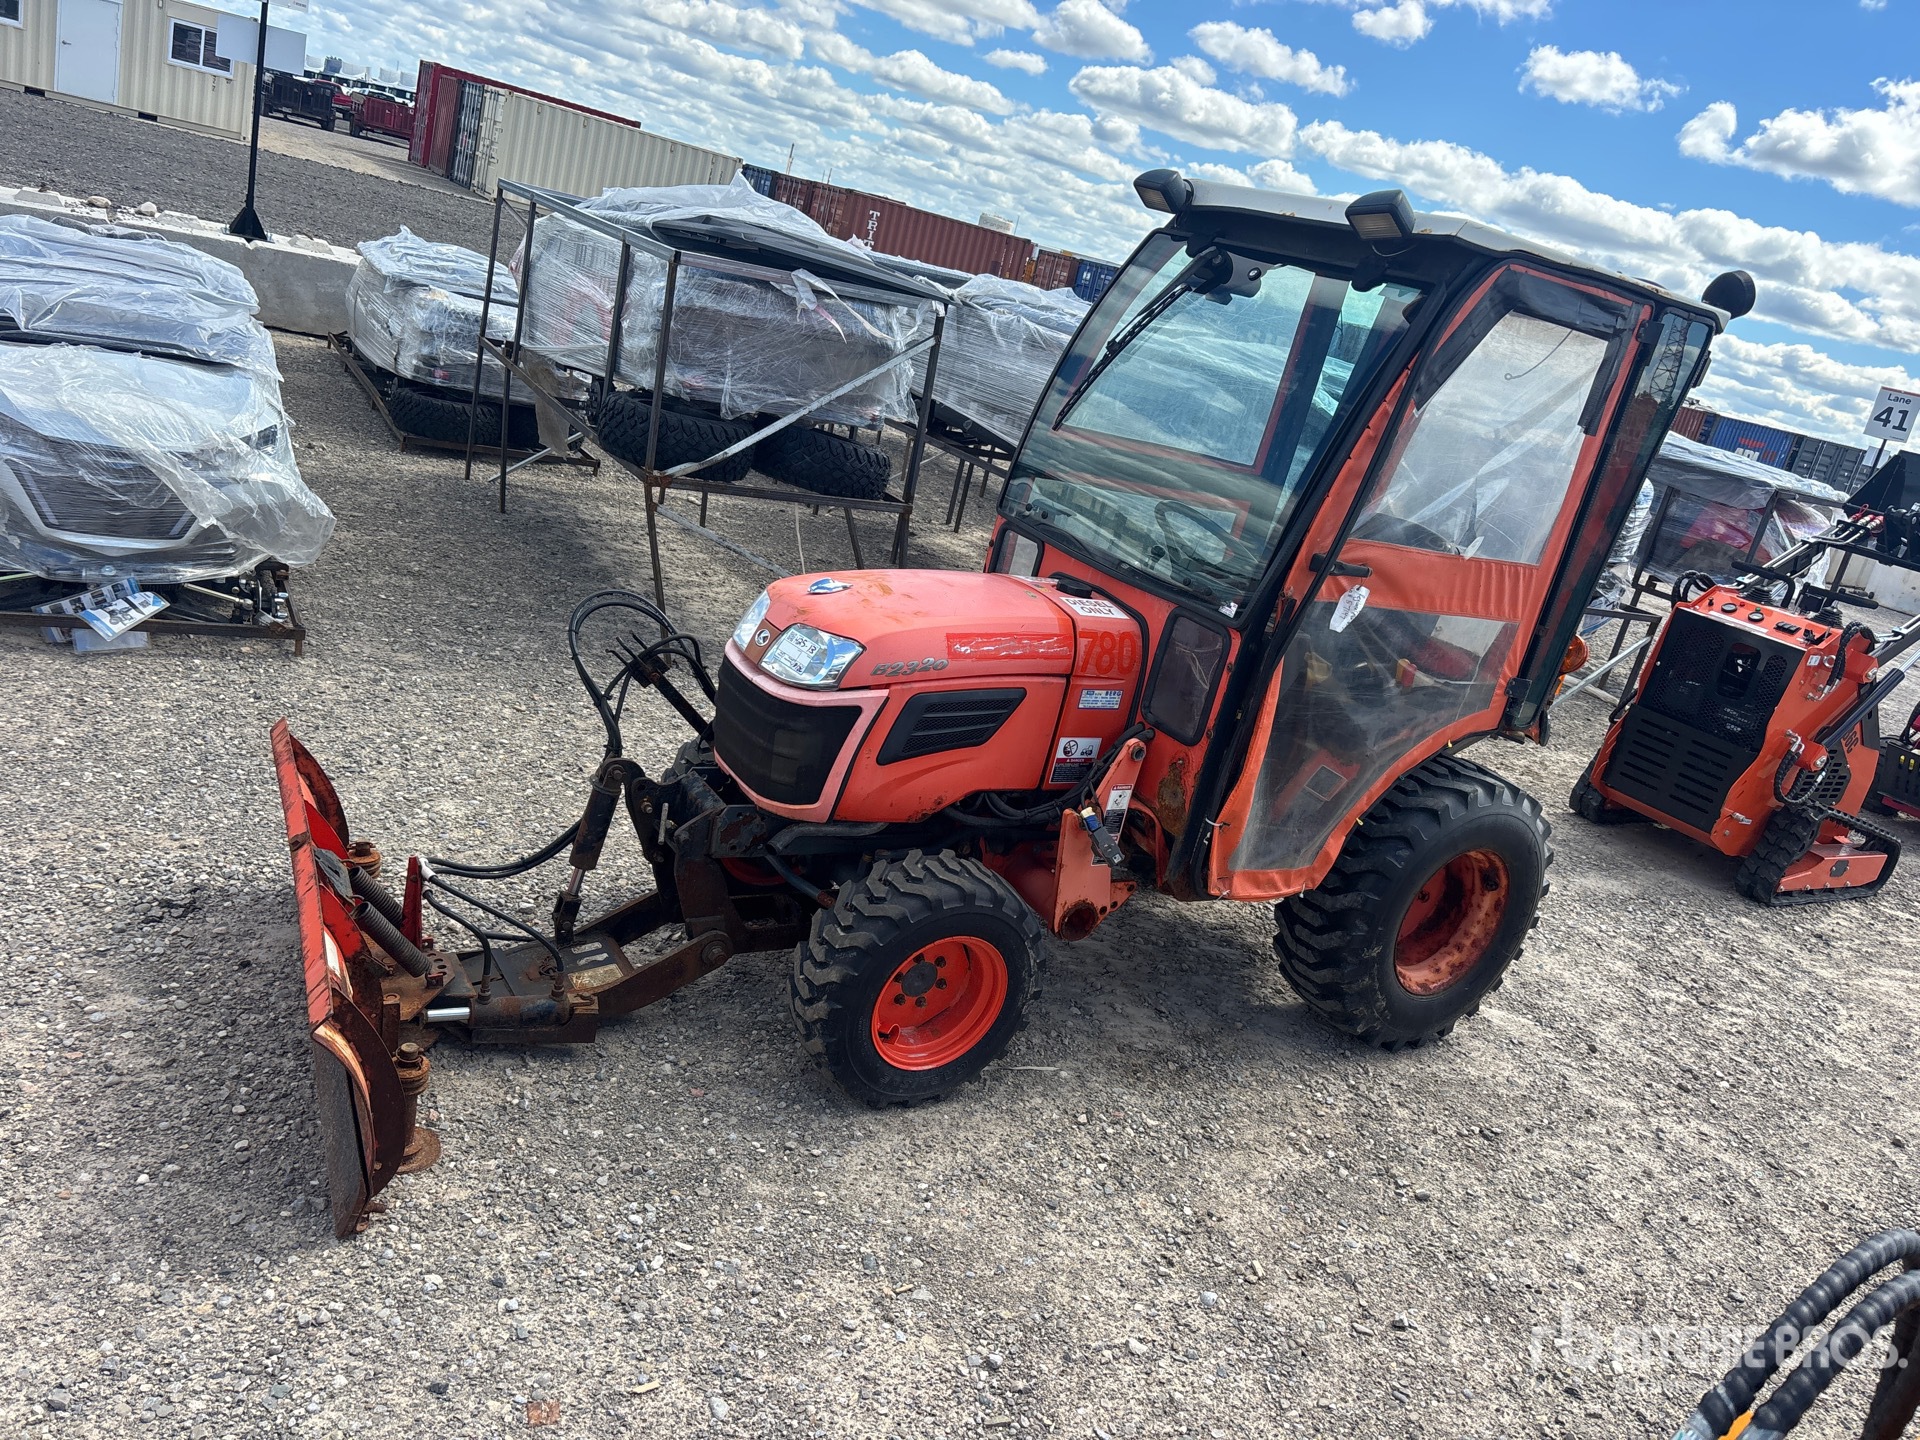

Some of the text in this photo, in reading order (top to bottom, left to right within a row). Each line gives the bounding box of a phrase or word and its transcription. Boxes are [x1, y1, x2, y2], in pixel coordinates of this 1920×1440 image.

[1887, 393, 1912, 405] Lane
[1873, 406, 1910, 432] 41
[1065, 598, 1115, 609] DIESEL
[1080, 606, 1115, 616] ONLY
[1078, 630, 1137, 675] 780
[870, 657, 949, 677] B2320
